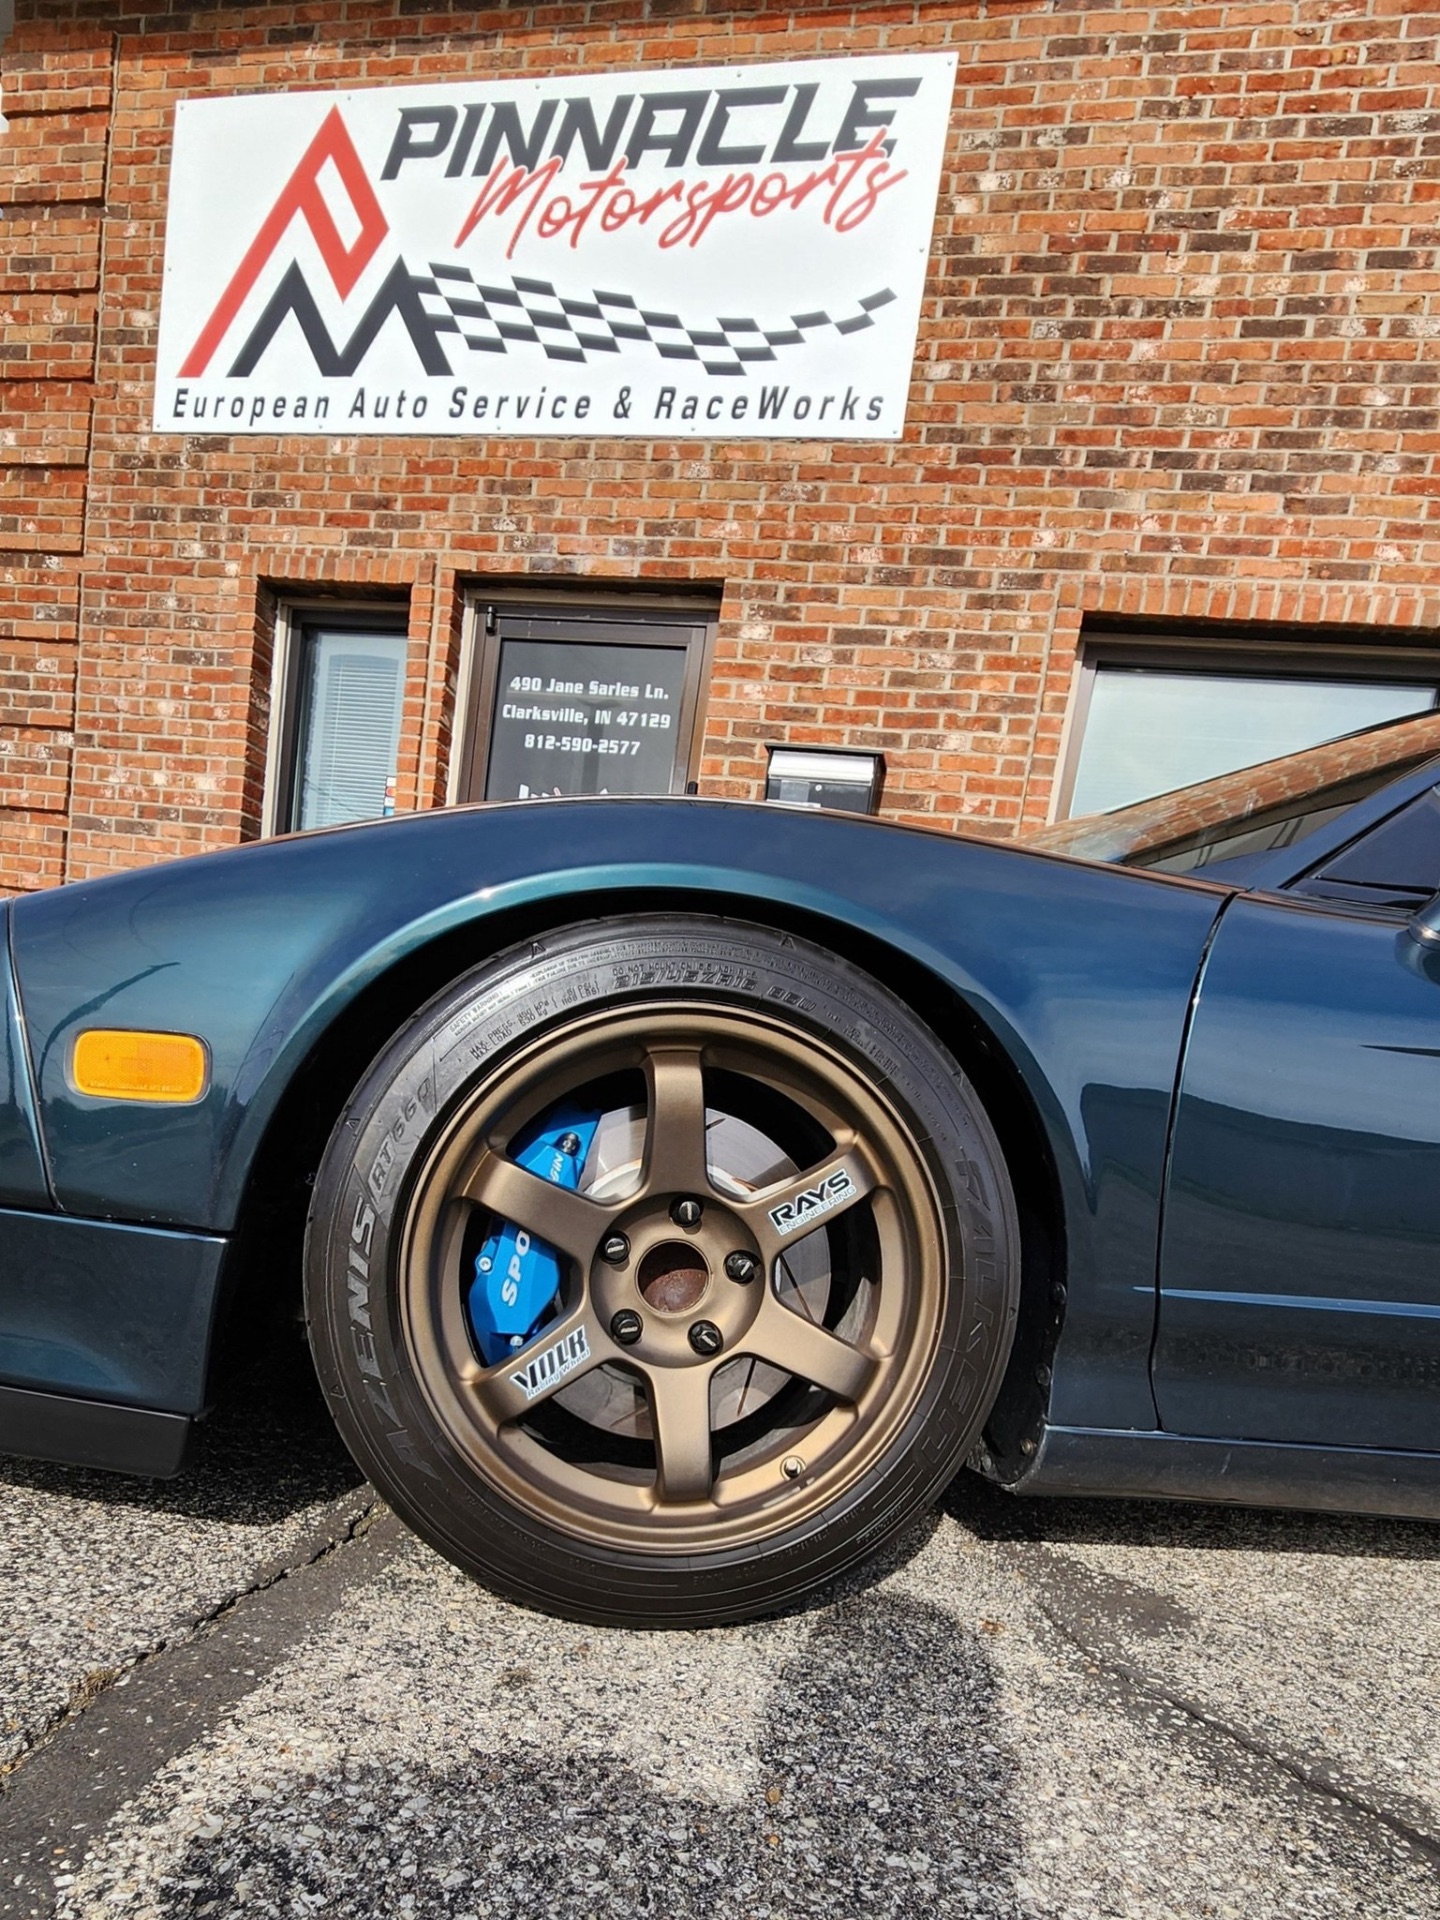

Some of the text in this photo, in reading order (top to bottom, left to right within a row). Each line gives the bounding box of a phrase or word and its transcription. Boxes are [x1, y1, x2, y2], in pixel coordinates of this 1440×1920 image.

[380, 76, 922, 182] PINNACLE
[453, 126, 908, 259] Motorsports
[172, 385, 884, 427] European Auto Service & RaceWorks
[510, 676, 669, 700] 490 Jane Sarles Ln.
[502, 704, 671, 729] Clarksville, IN 47129
[524, 734, 641, 756] 812-590-2577
[770, 1171, 851, 1227] RAYS
[779, 1185, 856, 1234] ENGINEERING
[501, 1229, 531, 1308] SPO
[512, 1327, 586, 1390] VOLK
[527, 1370, 561, 1399] Racing
